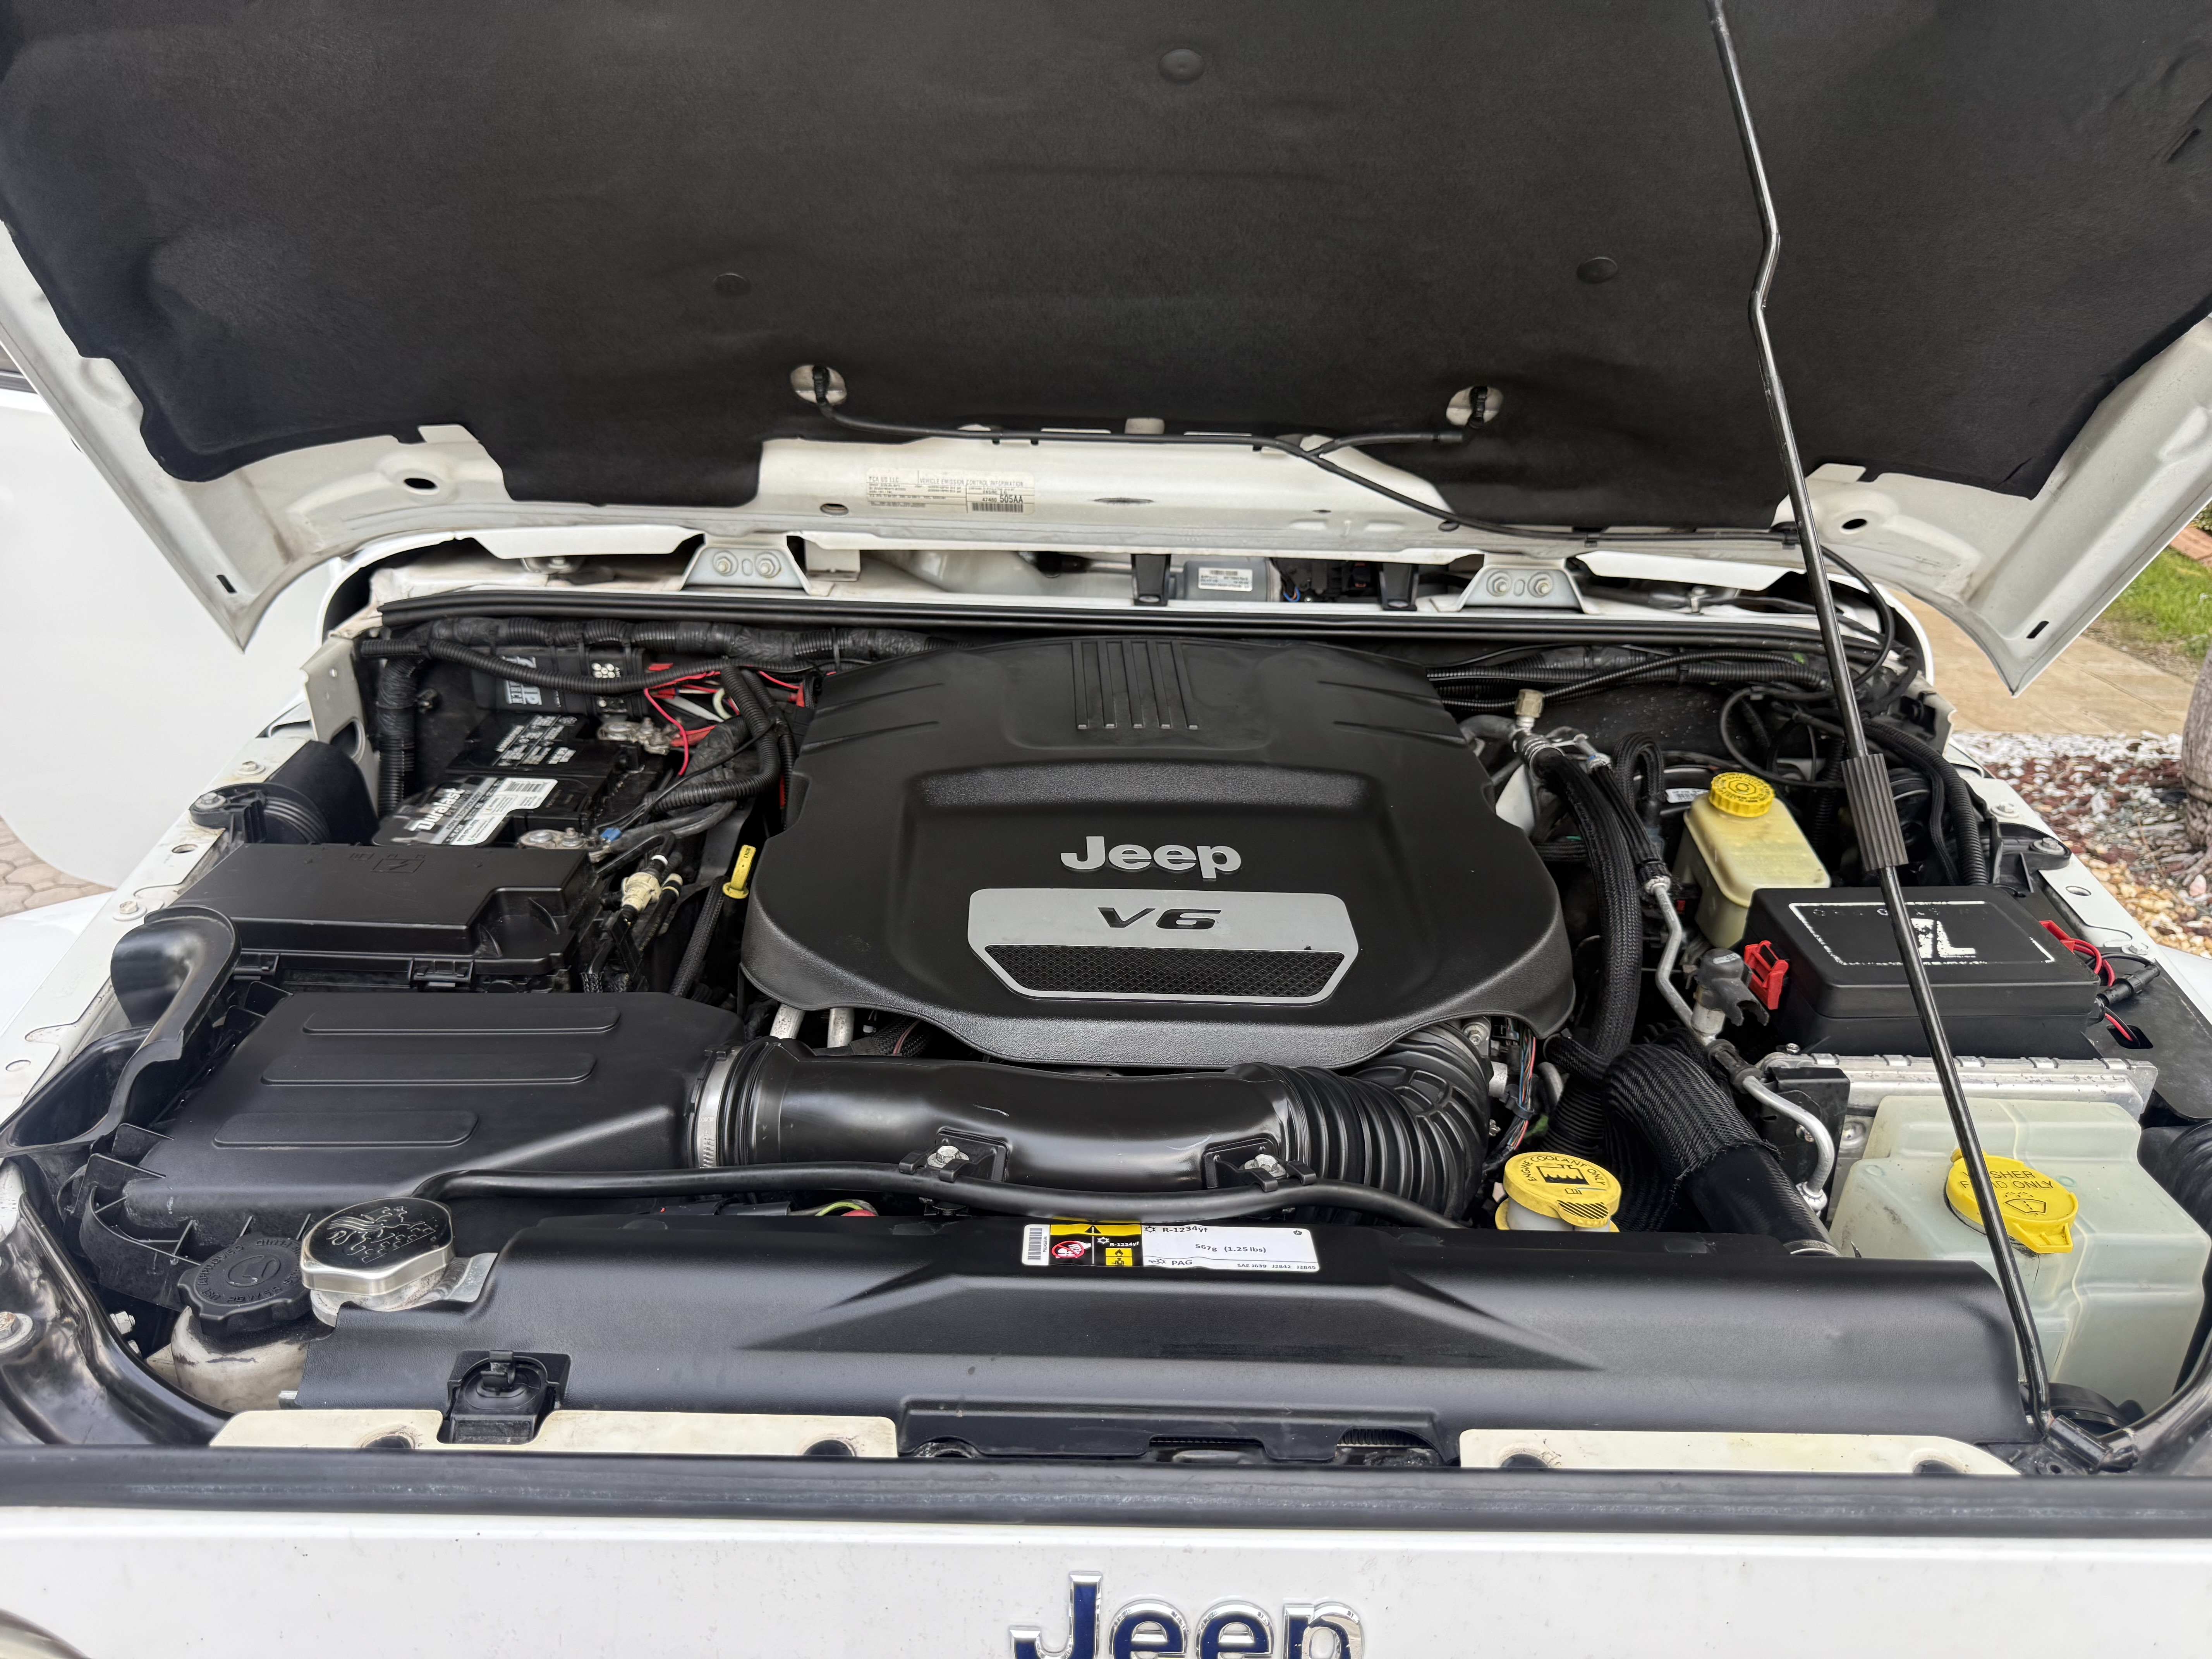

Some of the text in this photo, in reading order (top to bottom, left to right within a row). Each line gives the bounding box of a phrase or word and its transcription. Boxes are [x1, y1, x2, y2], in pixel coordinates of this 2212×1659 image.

[1000, 494, 1024, 503] 505AA
[410, 788, 465, 830] Duralast
[1060, 836, 1242, 880] Jeep
[1097, 907, 1221, 930] V6
[1520, 1155, 1606, 1186] ENGINE COOLANT ONLY
[2013, 1180, 2054, 1189] ONLY
[1195, 1243, 1218, 1252] 567g
